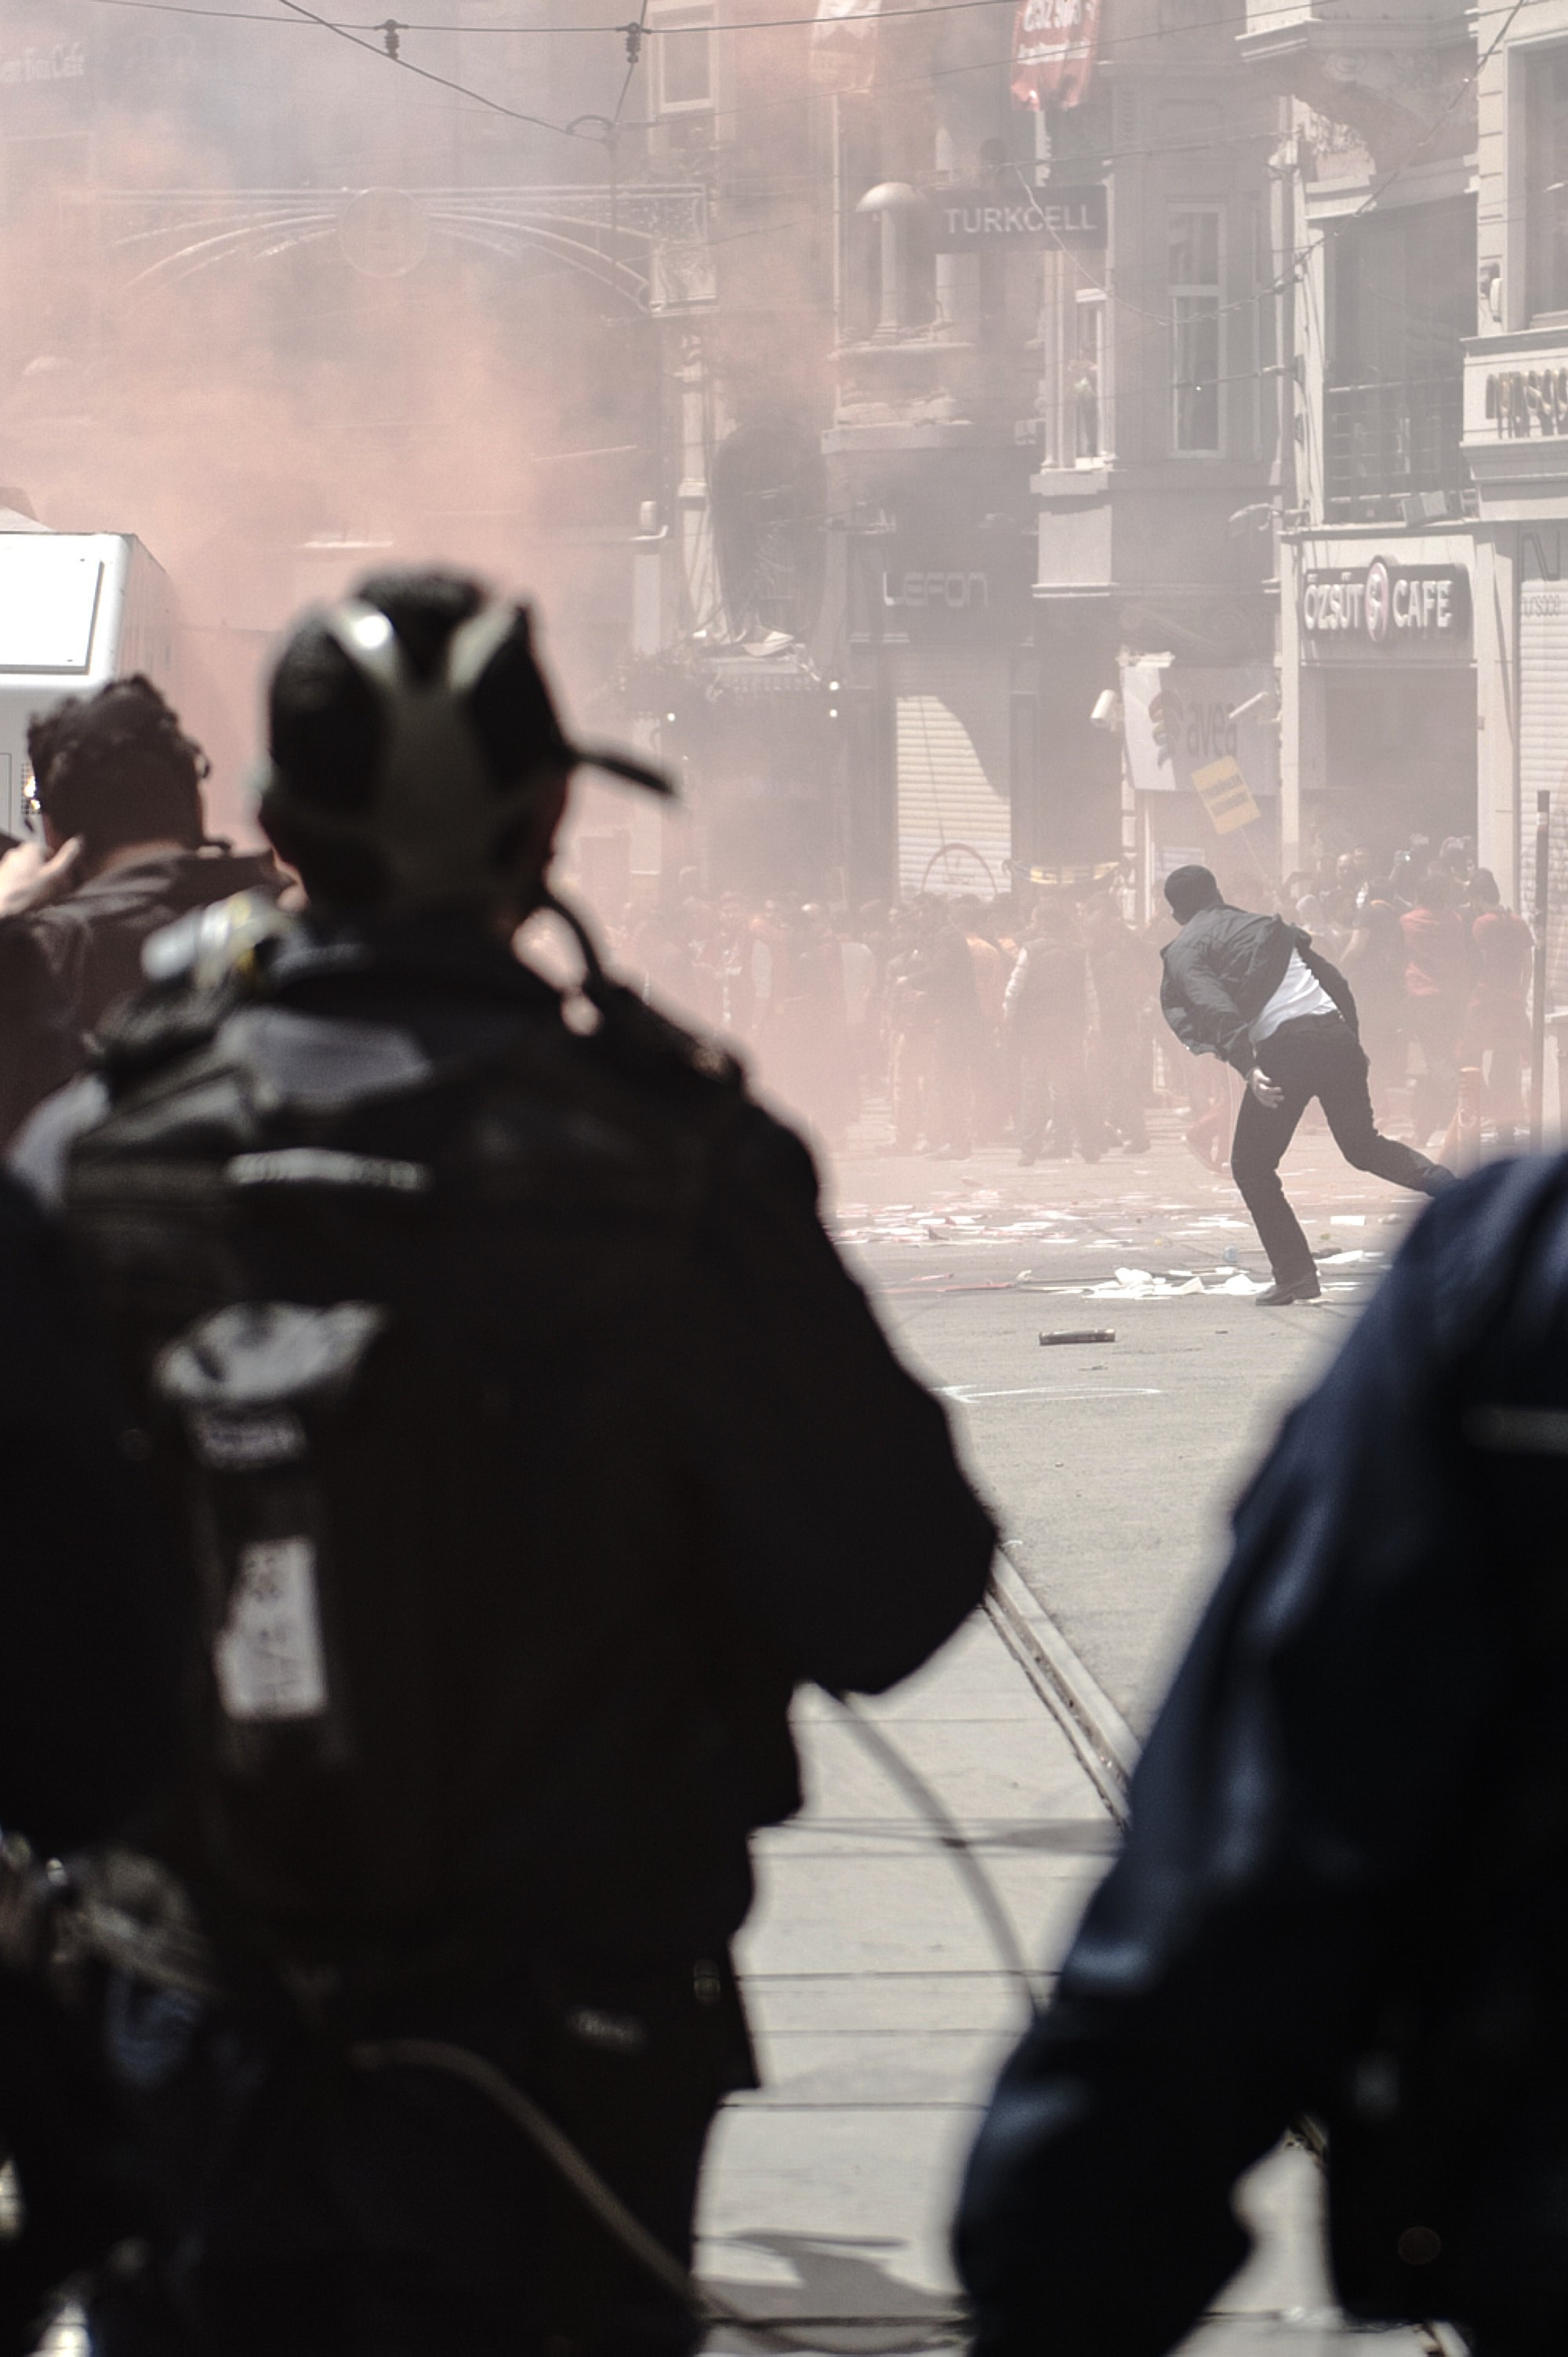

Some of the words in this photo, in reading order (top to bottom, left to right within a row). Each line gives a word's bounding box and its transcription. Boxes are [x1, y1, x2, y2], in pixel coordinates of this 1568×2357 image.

[943, 205, 1098, 234] TURKCELL
[1303, 571, 1364, 630] ÖZSÜT
[1392, 579, 1453, 628] CAFE
[1186, 702, 1237, 757] avea
